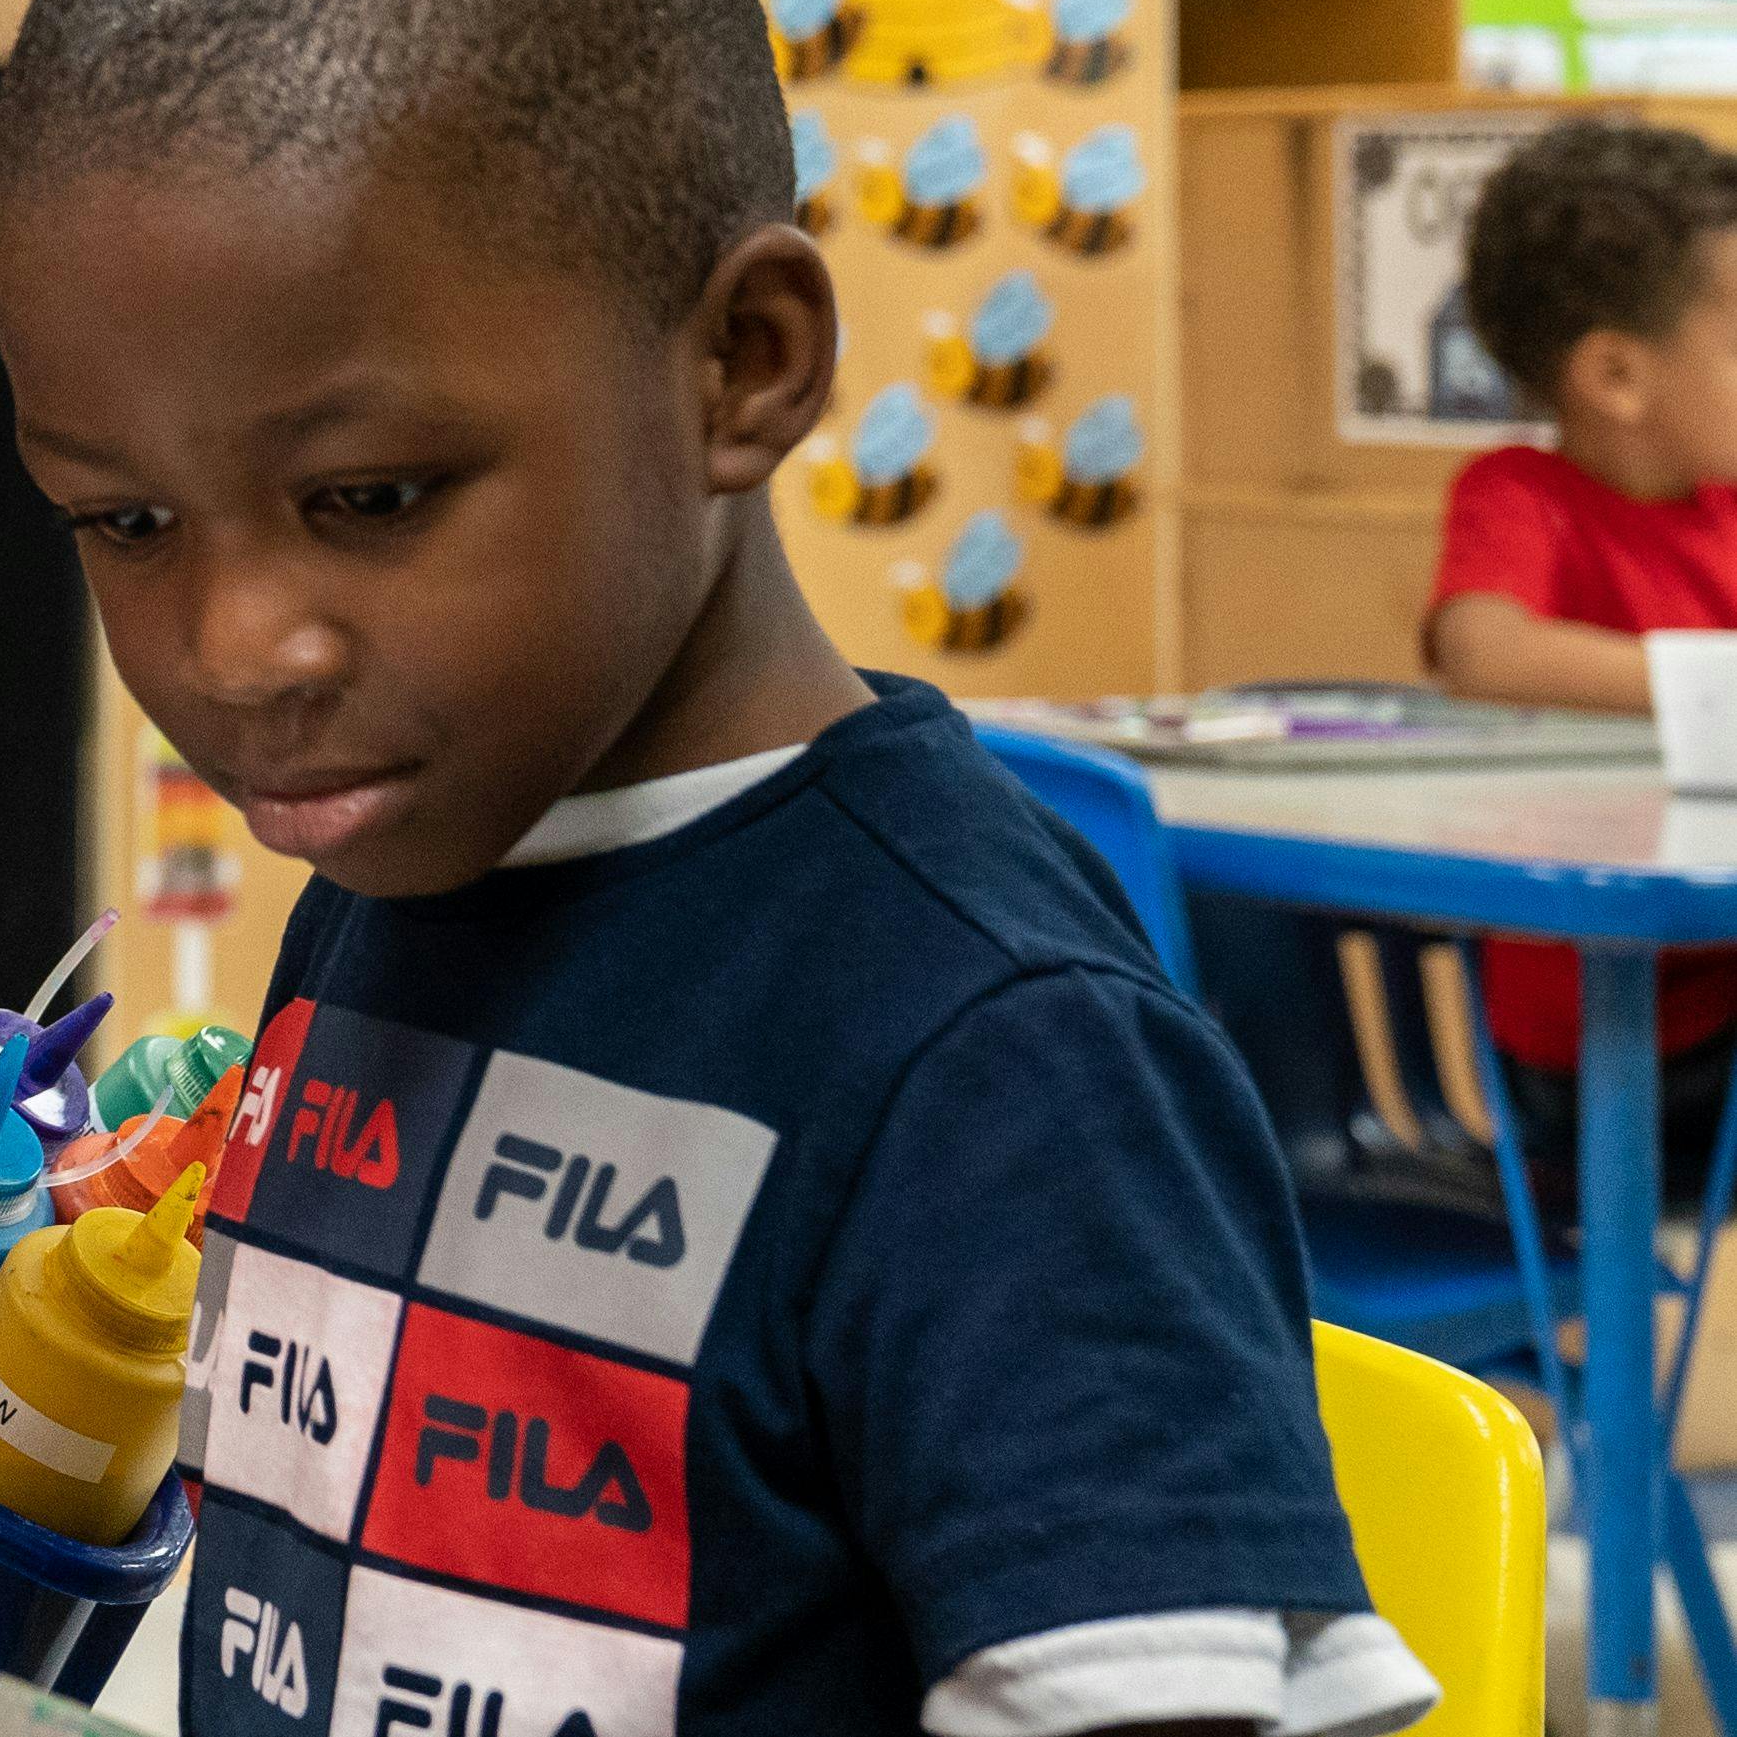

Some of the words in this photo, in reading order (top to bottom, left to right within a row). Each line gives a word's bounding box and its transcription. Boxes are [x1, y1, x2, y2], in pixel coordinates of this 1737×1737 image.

[286, 1079, 401, 1190] FILA
[473, 1132, 686, 1269] FILA
[239, 1329, 338, 1445] FILA
[414, 1393, 654, 1534] FILA
[220, 1586, 309, 1720] FILA
